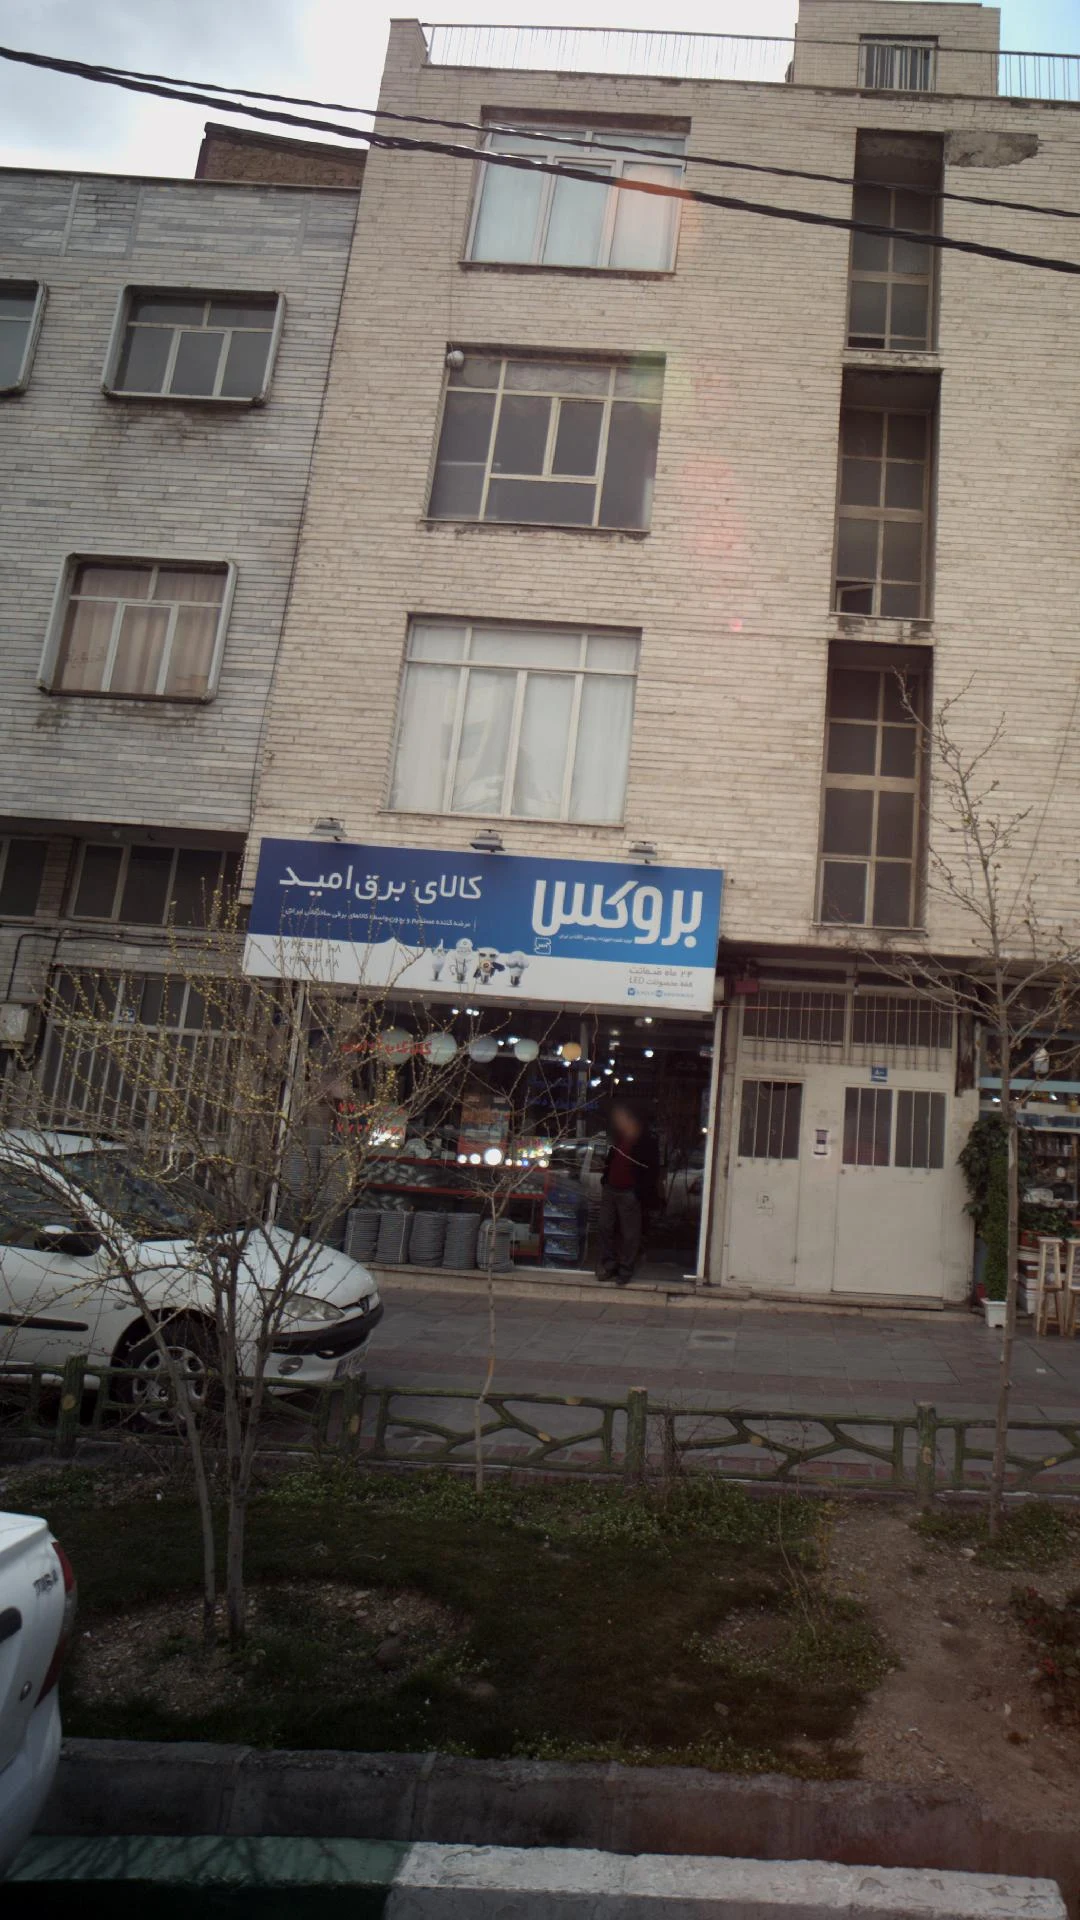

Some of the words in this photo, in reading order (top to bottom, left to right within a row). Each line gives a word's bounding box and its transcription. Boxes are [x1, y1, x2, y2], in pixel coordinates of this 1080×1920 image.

[279, 864, 354, 897] امید
[355, 874, 406, 902] برق
[414, 874, 483, 905] کالای
[531, 879, 704, 949] بروکس
